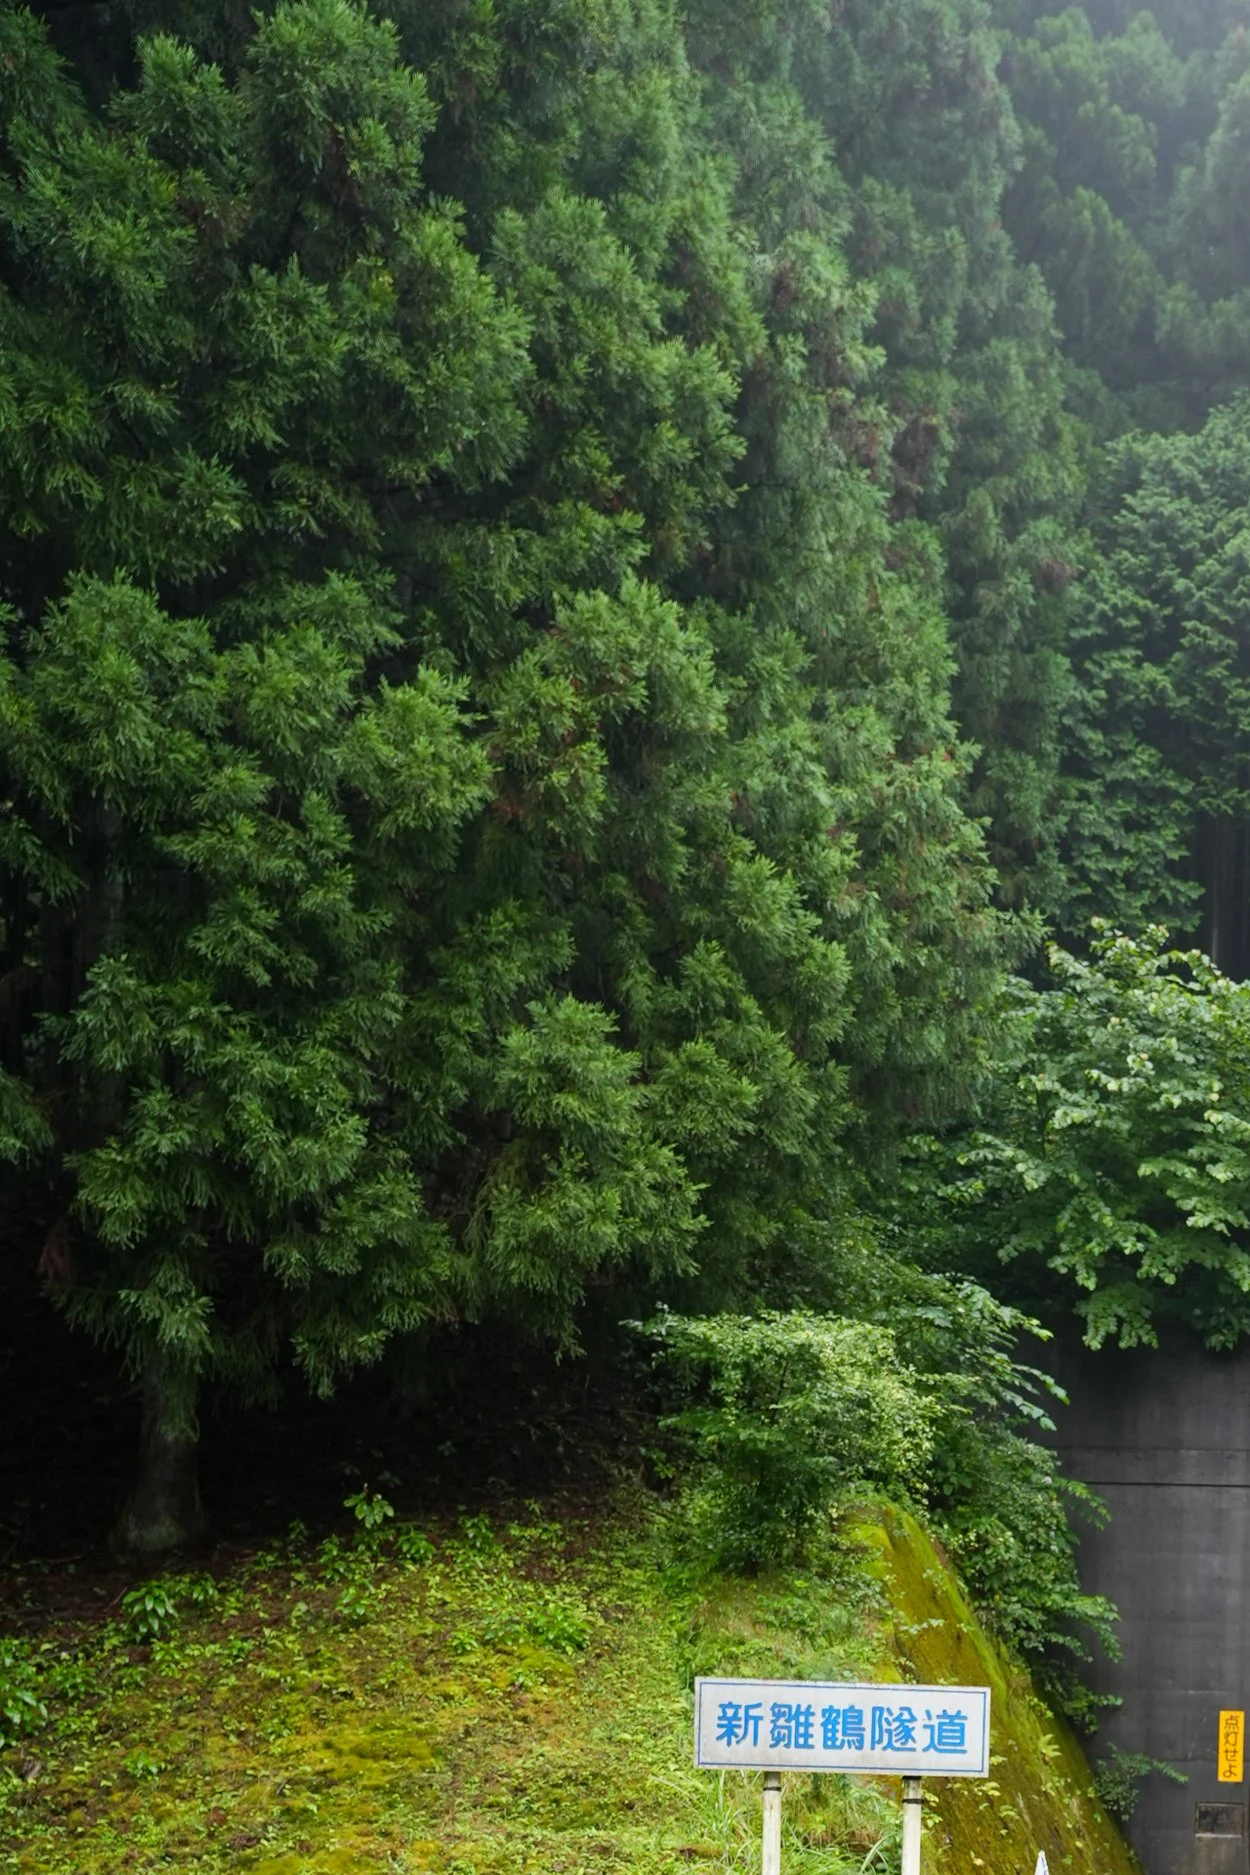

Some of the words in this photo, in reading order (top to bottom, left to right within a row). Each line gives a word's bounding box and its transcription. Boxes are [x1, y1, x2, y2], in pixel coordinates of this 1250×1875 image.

[715, 1700, 969, 1754] 新雛鶴隧道
[1222, 1713, 1240, 1779] 点灯せよ
